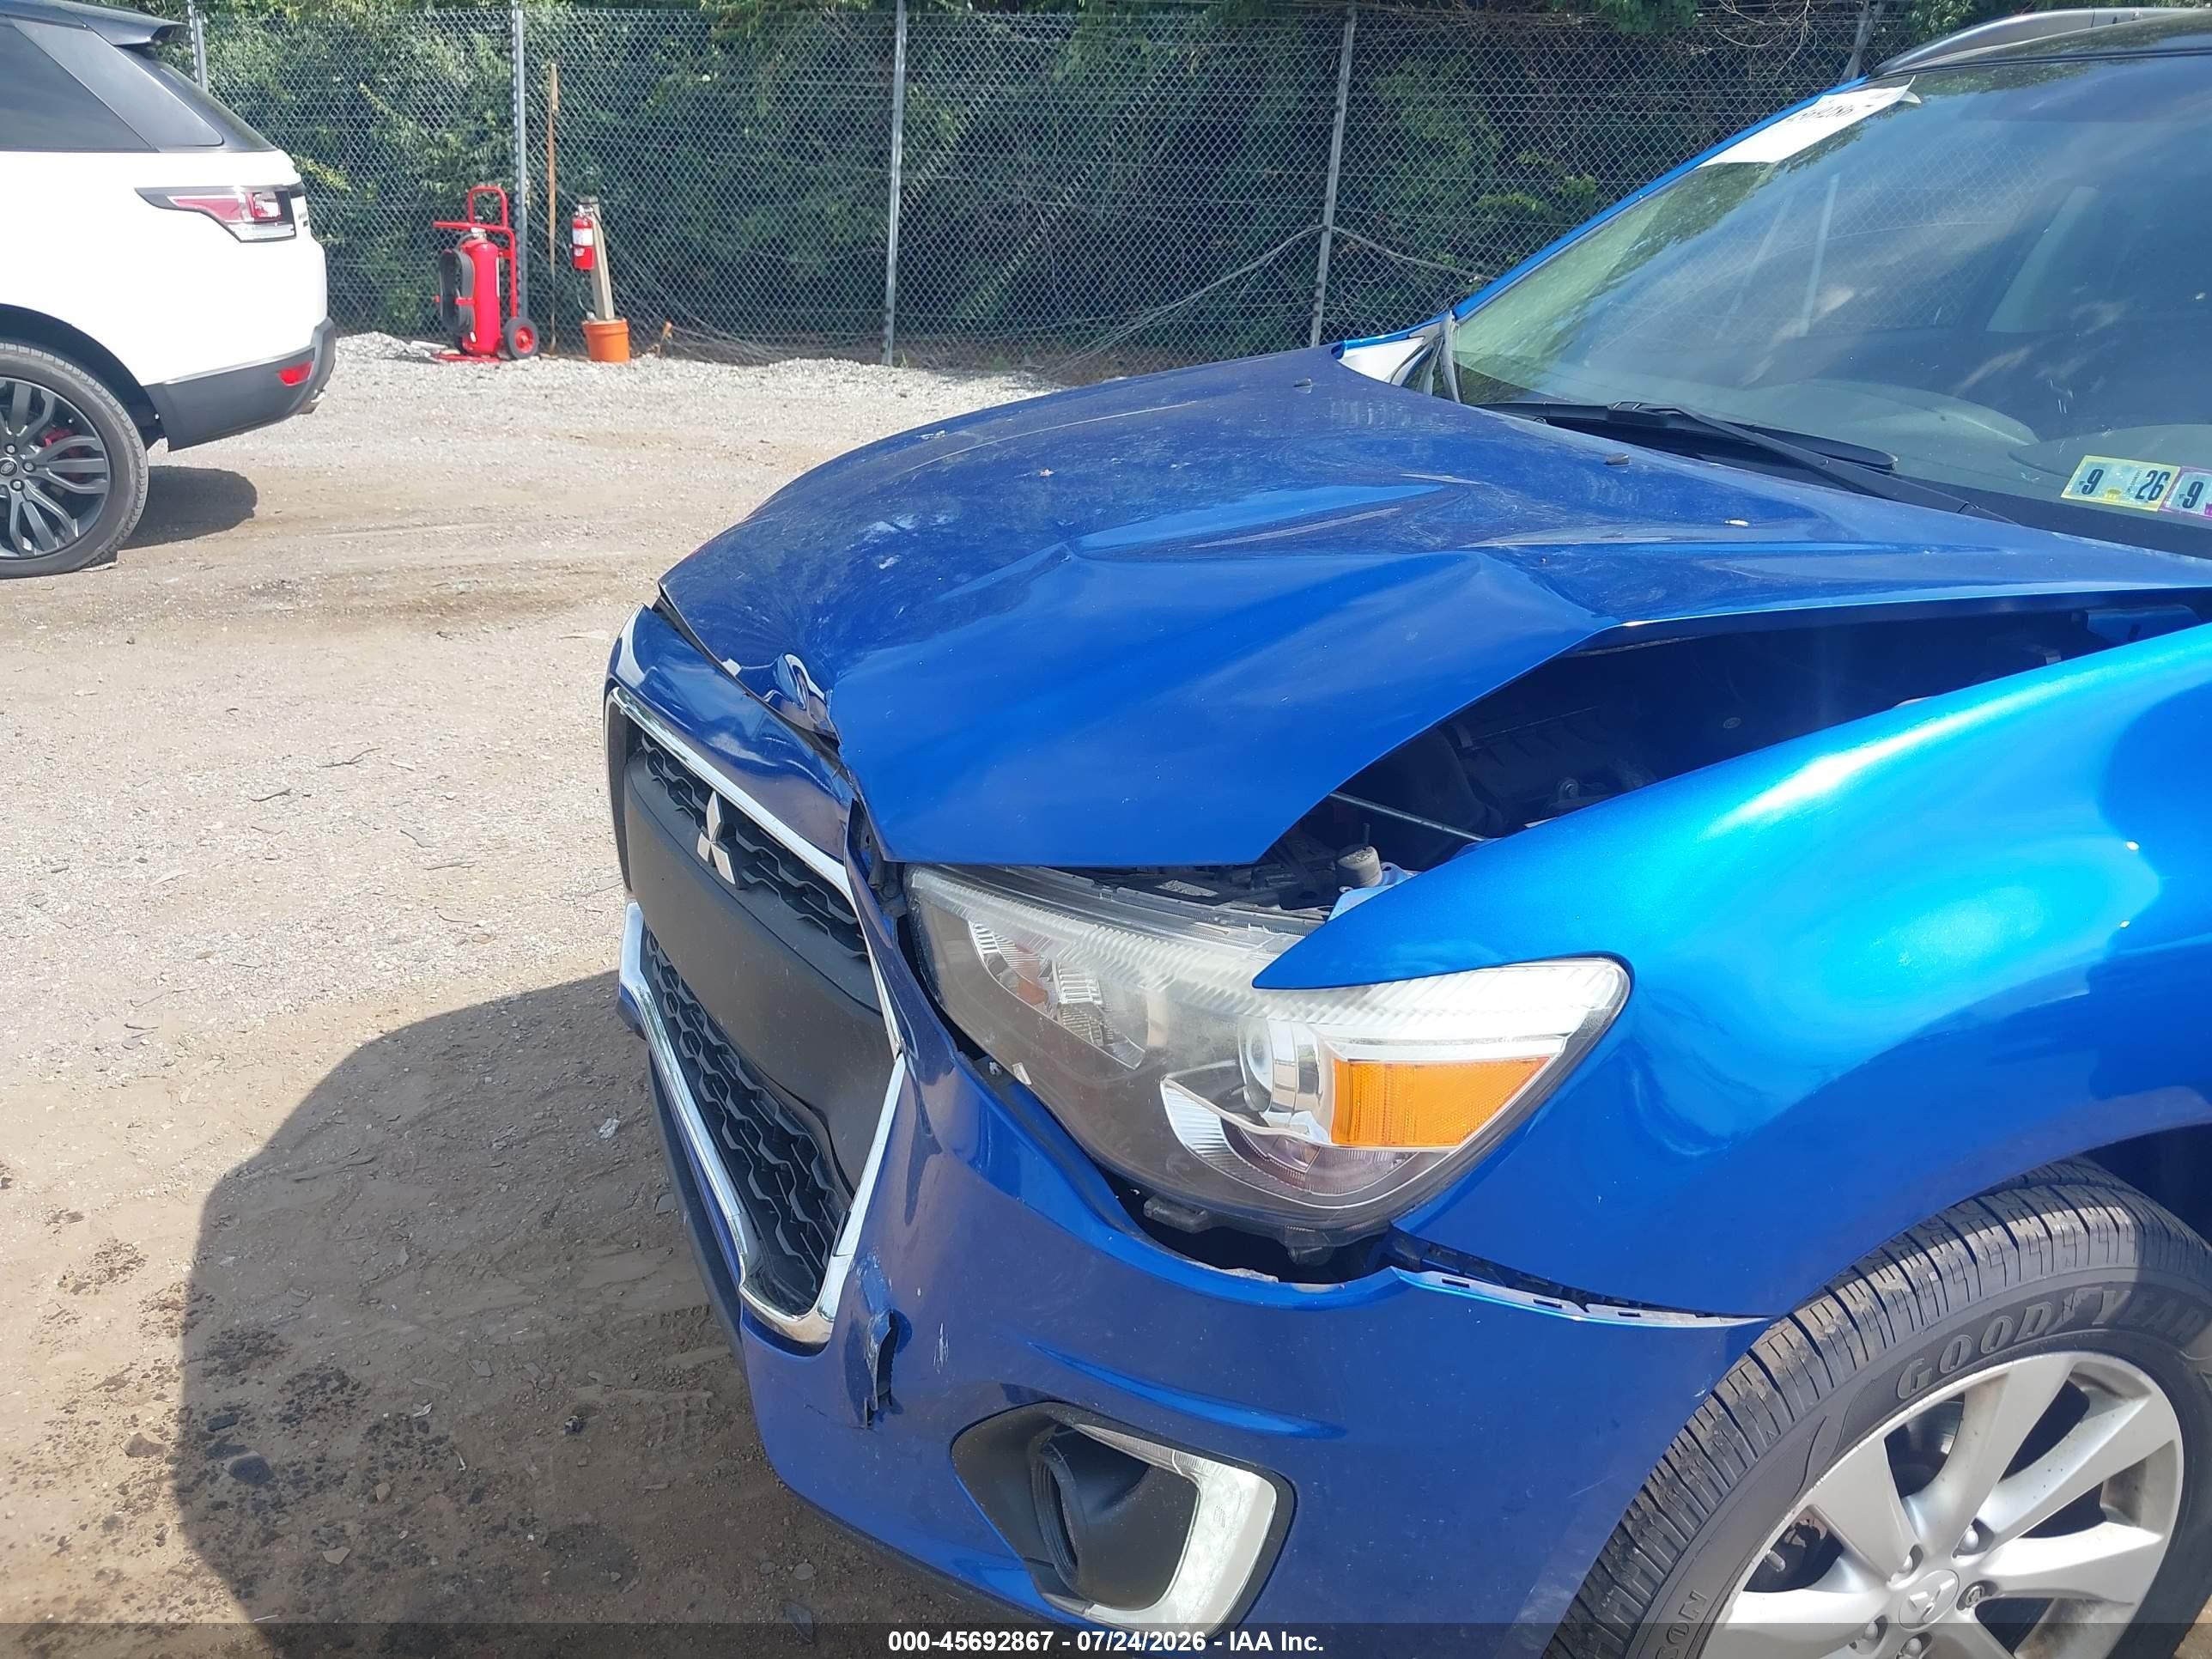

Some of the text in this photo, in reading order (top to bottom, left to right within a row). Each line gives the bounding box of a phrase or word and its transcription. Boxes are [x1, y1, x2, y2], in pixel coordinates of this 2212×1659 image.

[2081, 468, 2104, 495] 9
[2136, 470, 2171, 501] 26
[2182, 481, 2204, 509] 9
